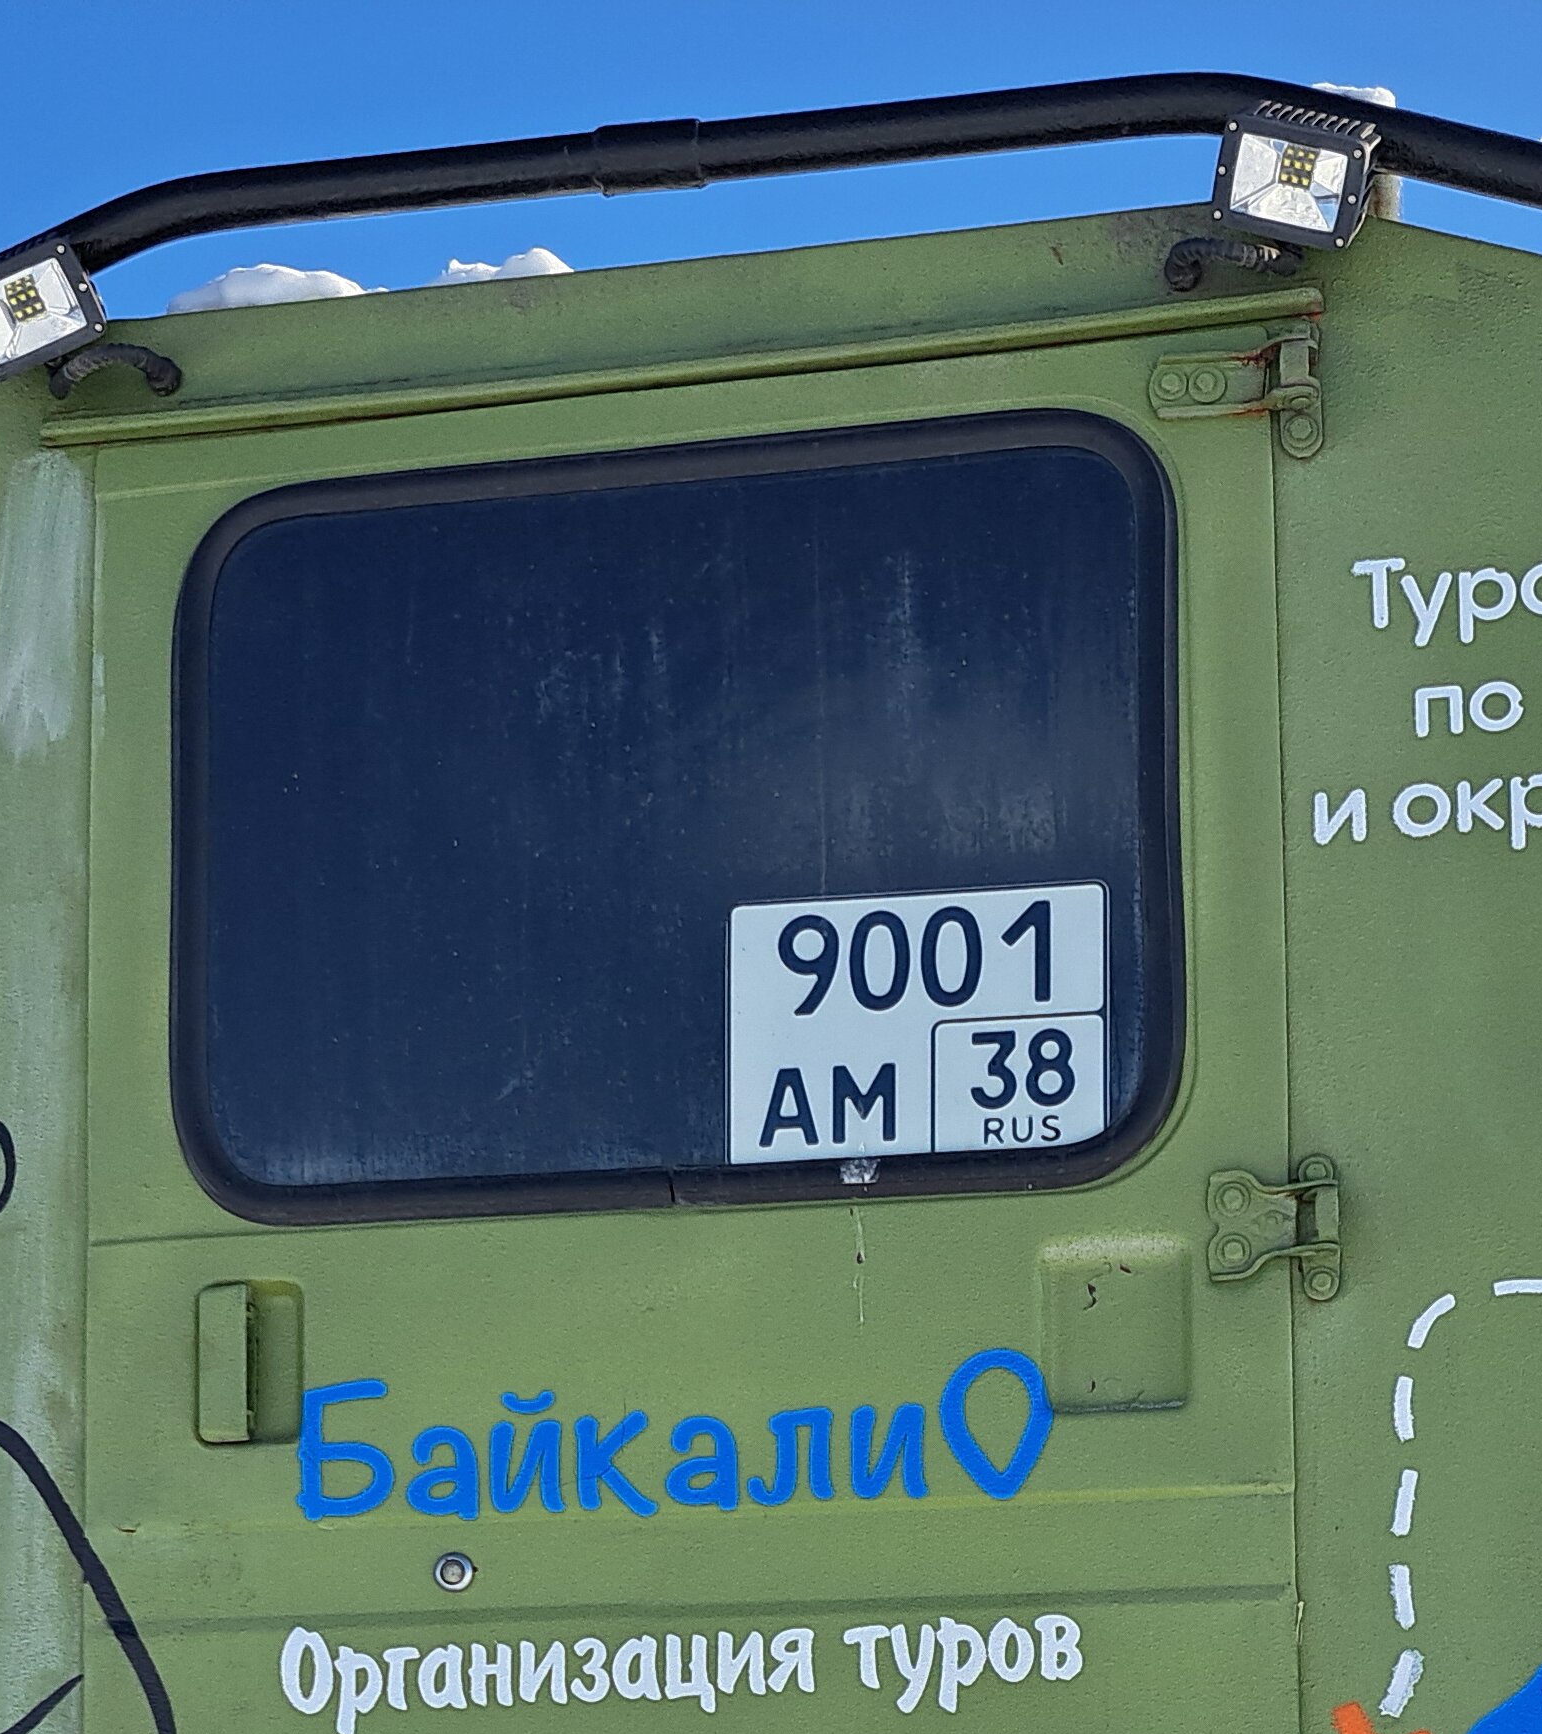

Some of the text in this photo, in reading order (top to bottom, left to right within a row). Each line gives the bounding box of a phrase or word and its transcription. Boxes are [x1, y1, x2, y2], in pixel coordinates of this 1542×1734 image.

[1413, 680, 1524, 738] по
[1312, 787, 1368, 845] и
[776, 898, 1053, 1018] 9001
[969, 1026, 1077, 1111] 38
[982, 1114, 1063, 1146] RUS
[842, 1613, 1084, 1714] туров
